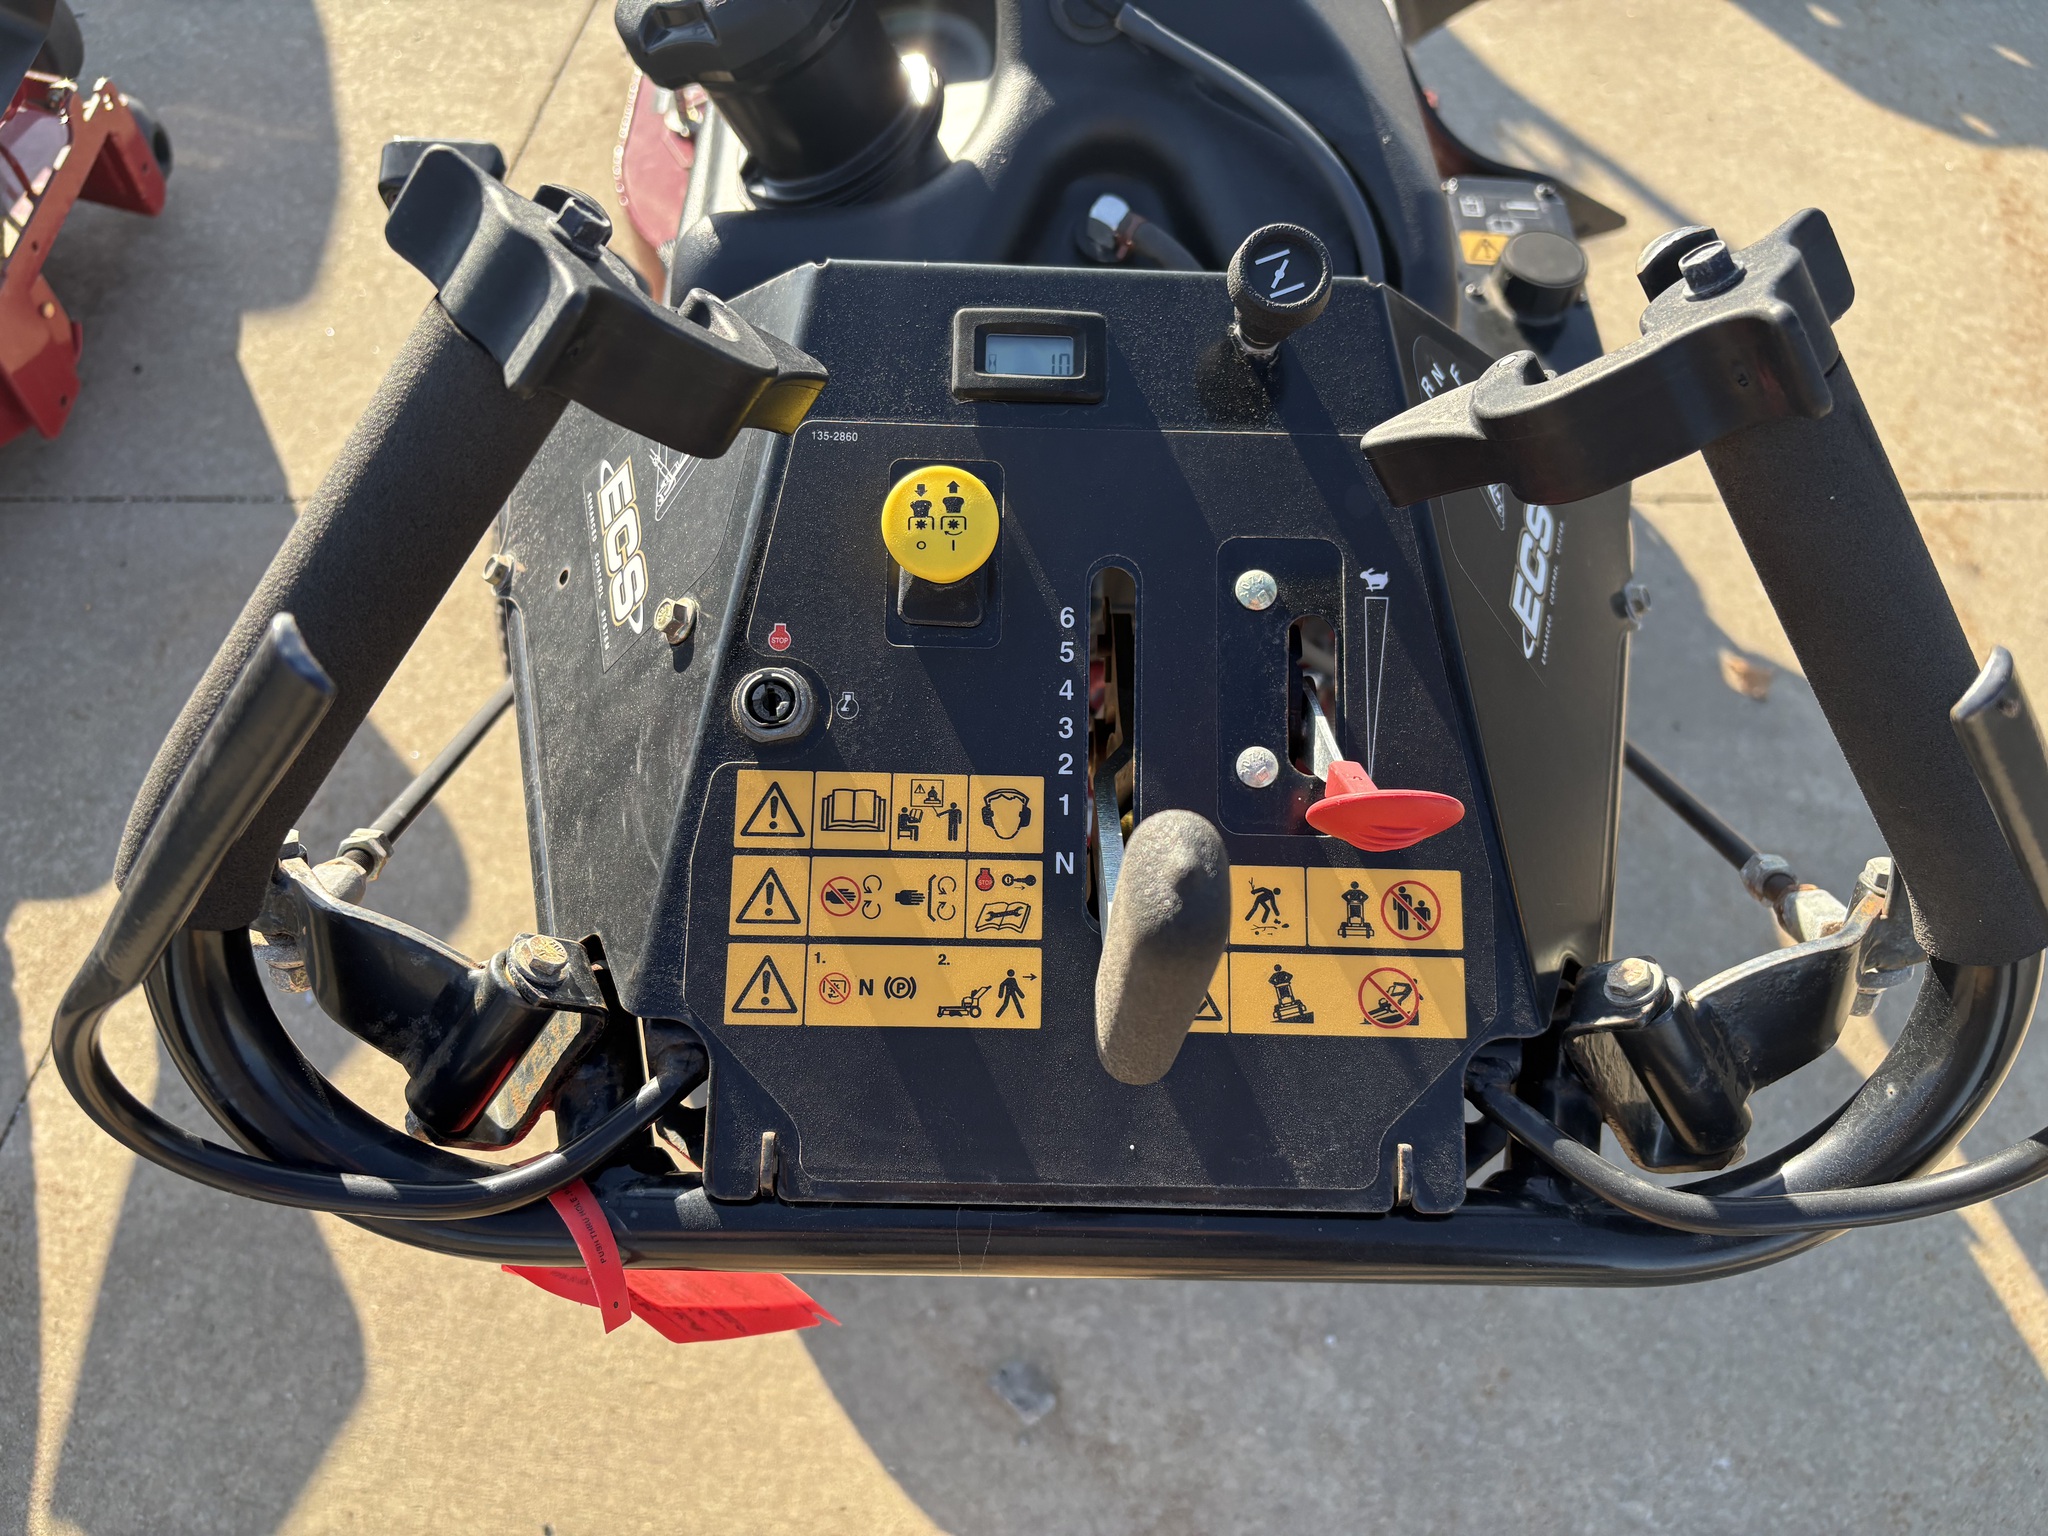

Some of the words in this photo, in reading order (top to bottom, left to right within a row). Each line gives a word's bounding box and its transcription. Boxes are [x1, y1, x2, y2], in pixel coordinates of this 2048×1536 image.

[1421, 376, 1435, 399] R
[1431, 362, 1446, 388] N
[1450, 362, 1463, 387] F
[811, 430, 859, 442] 135-2860
[597, 455, 649, 626] ECS
[1509, 503, 1555, 648] ECS
[594, 552, 604, 600] CONTROL
[601, 609, 611, 651] SYSTEM
[1060, 606, 1075, 628] 6
[771, 636, 789, 644] STOP
[1059, 641, 1075, 663] 5
[1058, 679, 1074, 701] 4
[1058, 716, 1074, 739] 3
[1058, 753, 1074, 775] 2
[1058, 793, 1069, 816] 1
[1055, 851, 1075, 875] N
[814, 952, 826, 964] 1.
[937, 954, 950, 966] 2.
[858, 979, 874, 996] N
[569, 1196, 587, 1219] HOLE
[583, 1217, 598, 1240] THRU
[594, 1239, 607, 1264] PUSH
